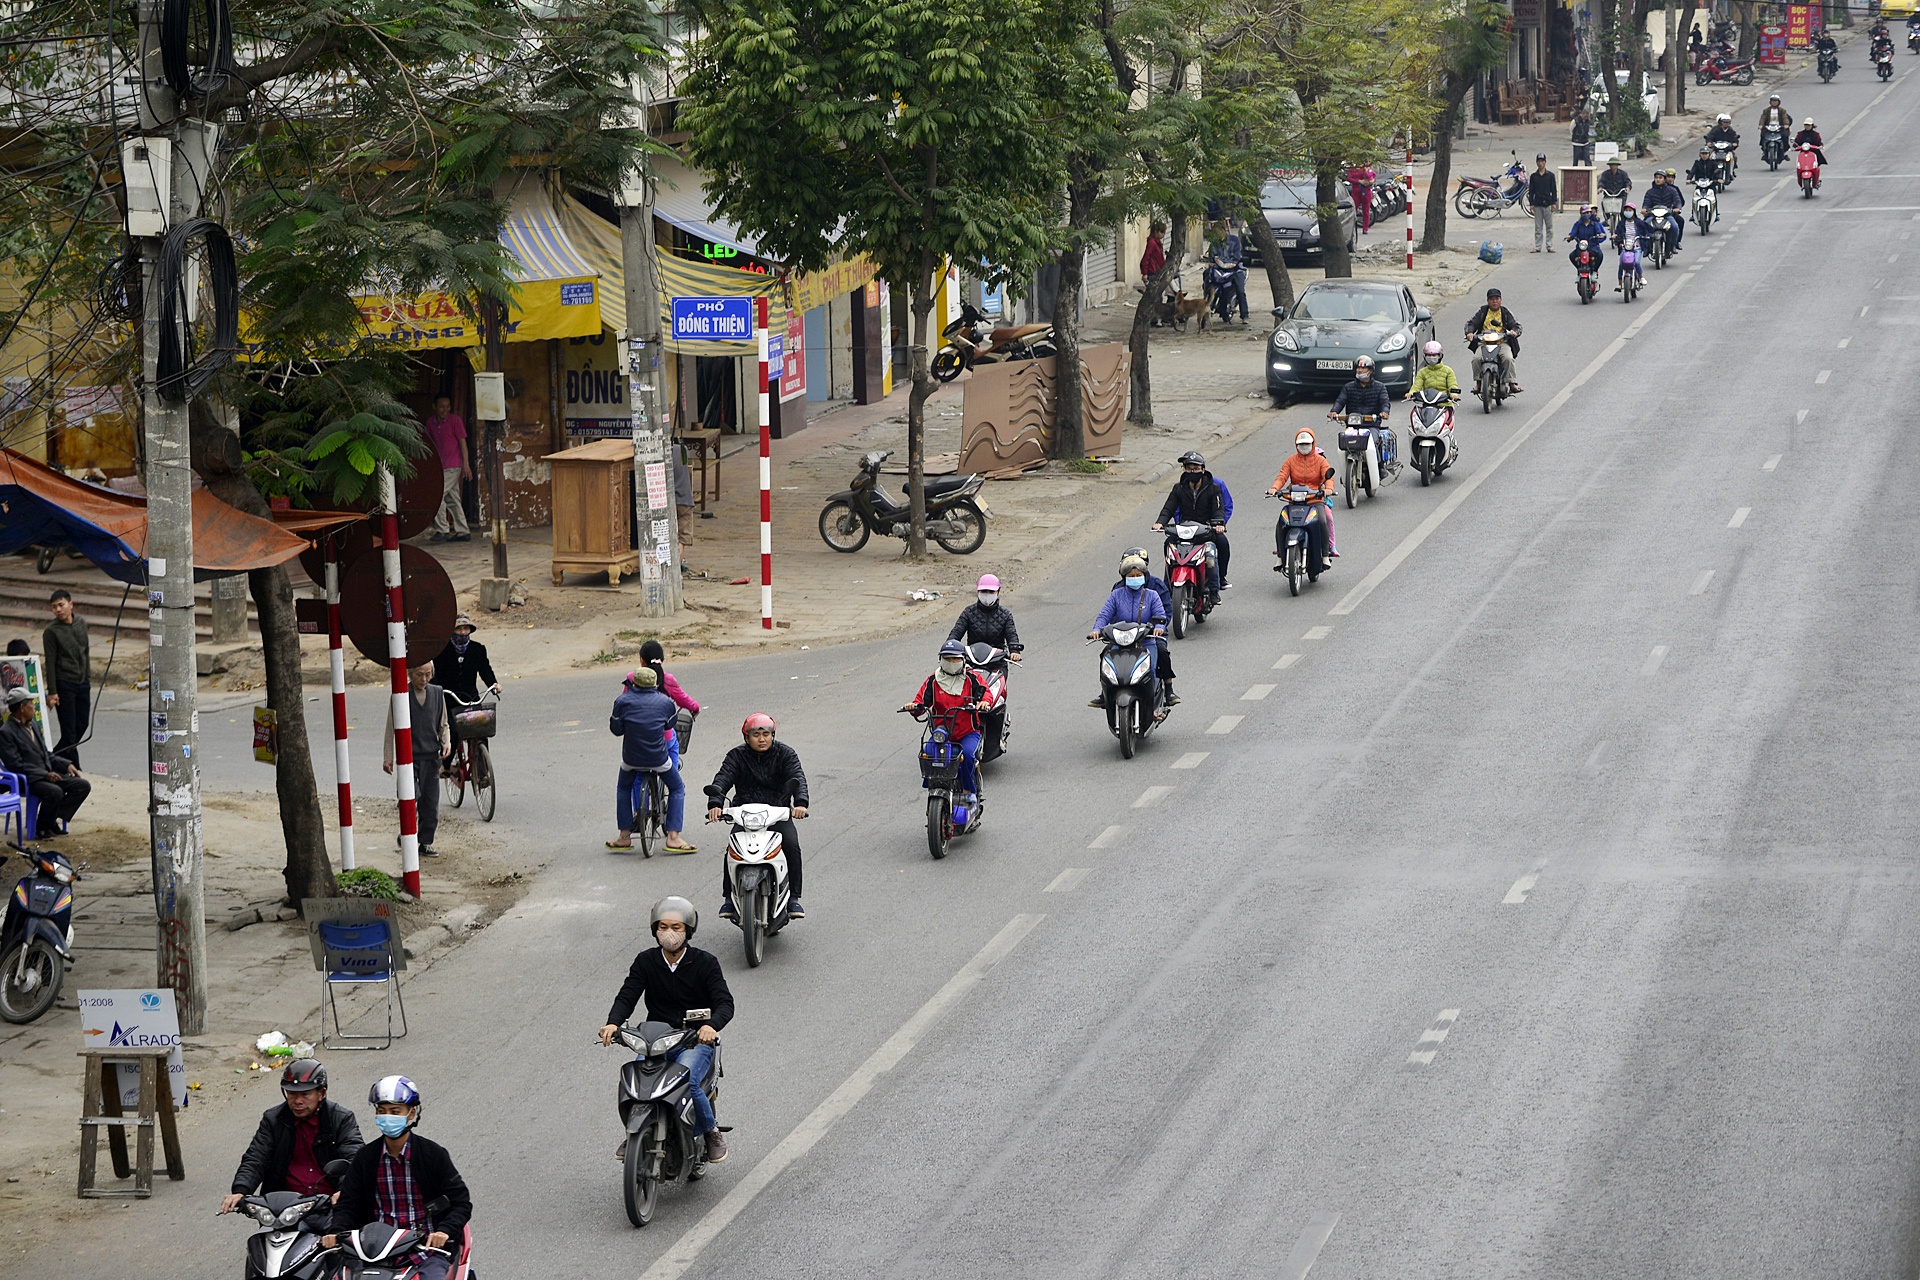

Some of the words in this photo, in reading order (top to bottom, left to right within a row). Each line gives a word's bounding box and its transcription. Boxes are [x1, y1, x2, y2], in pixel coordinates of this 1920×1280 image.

[1791, 6, 1807, 15] BỌC
[1792, 16, 1805, 25] LẠI
[1791, 25, 1806, 35] GHẾ
[1789, 37, 1807, 45] SOFA
[704, 243, 738, 258] LED
[697, 299, 725, 312] PHỐ
[678, 312, 710, 333] ĐỒNG
[712, 314, 745, 336] THIỆN
[567, 358, 623, 405] ĐỒNG
[341, 957, 378, 967] Vina
